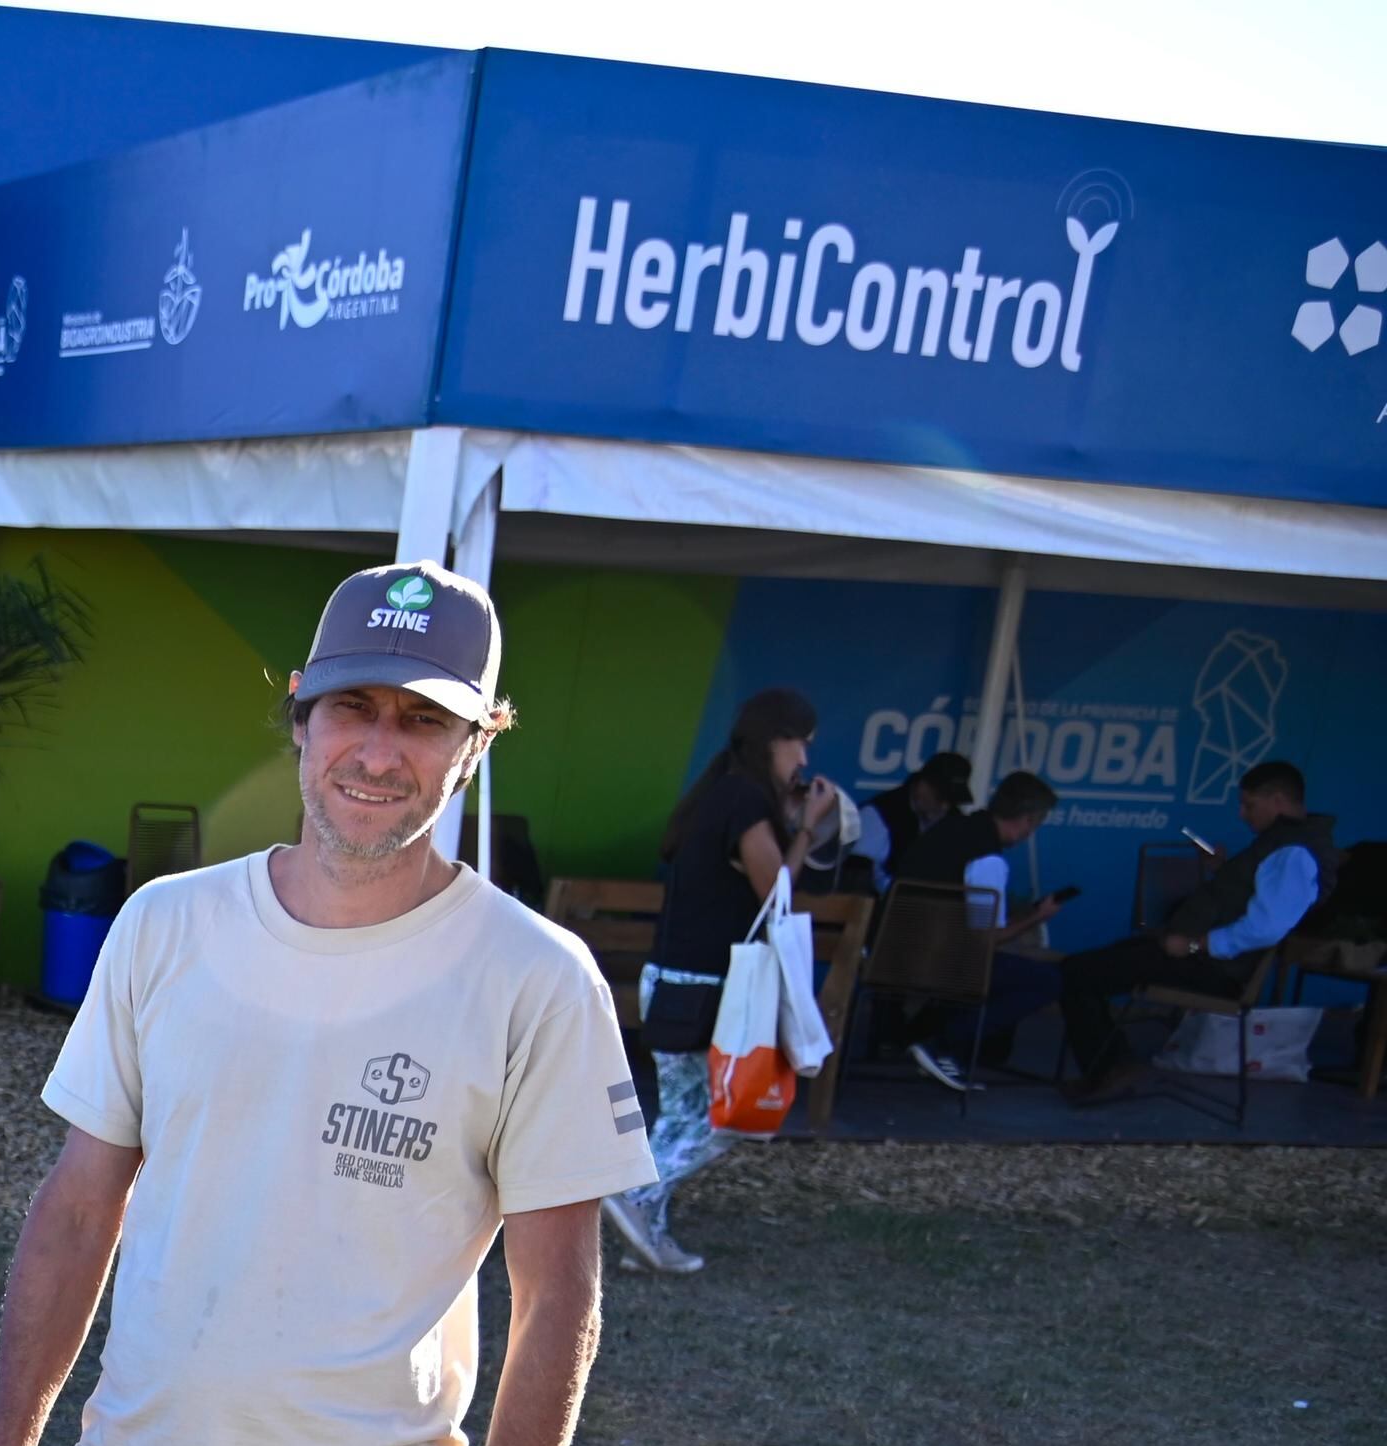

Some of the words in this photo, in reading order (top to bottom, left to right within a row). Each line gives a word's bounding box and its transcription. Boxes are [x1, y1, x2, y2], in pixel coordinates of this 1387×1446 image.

[563, 196, 1119, 372] HerbiControl
[327, 294, 399, 321] ARGENTINA
[367, 608, 430, 633] STINE
[1068, 804, 1168, 830] haciendo
[379, 1052, 412, 1105] S
[321, 1103, 438, 1161] STINERS
[333, 1164, 360, 1180] STINE
[362, 1170, 404, 1189] SEMILLAS
[335, 1152, 355, 1166] RED
[356, 1156, 405, 1177] COMERCIAL
